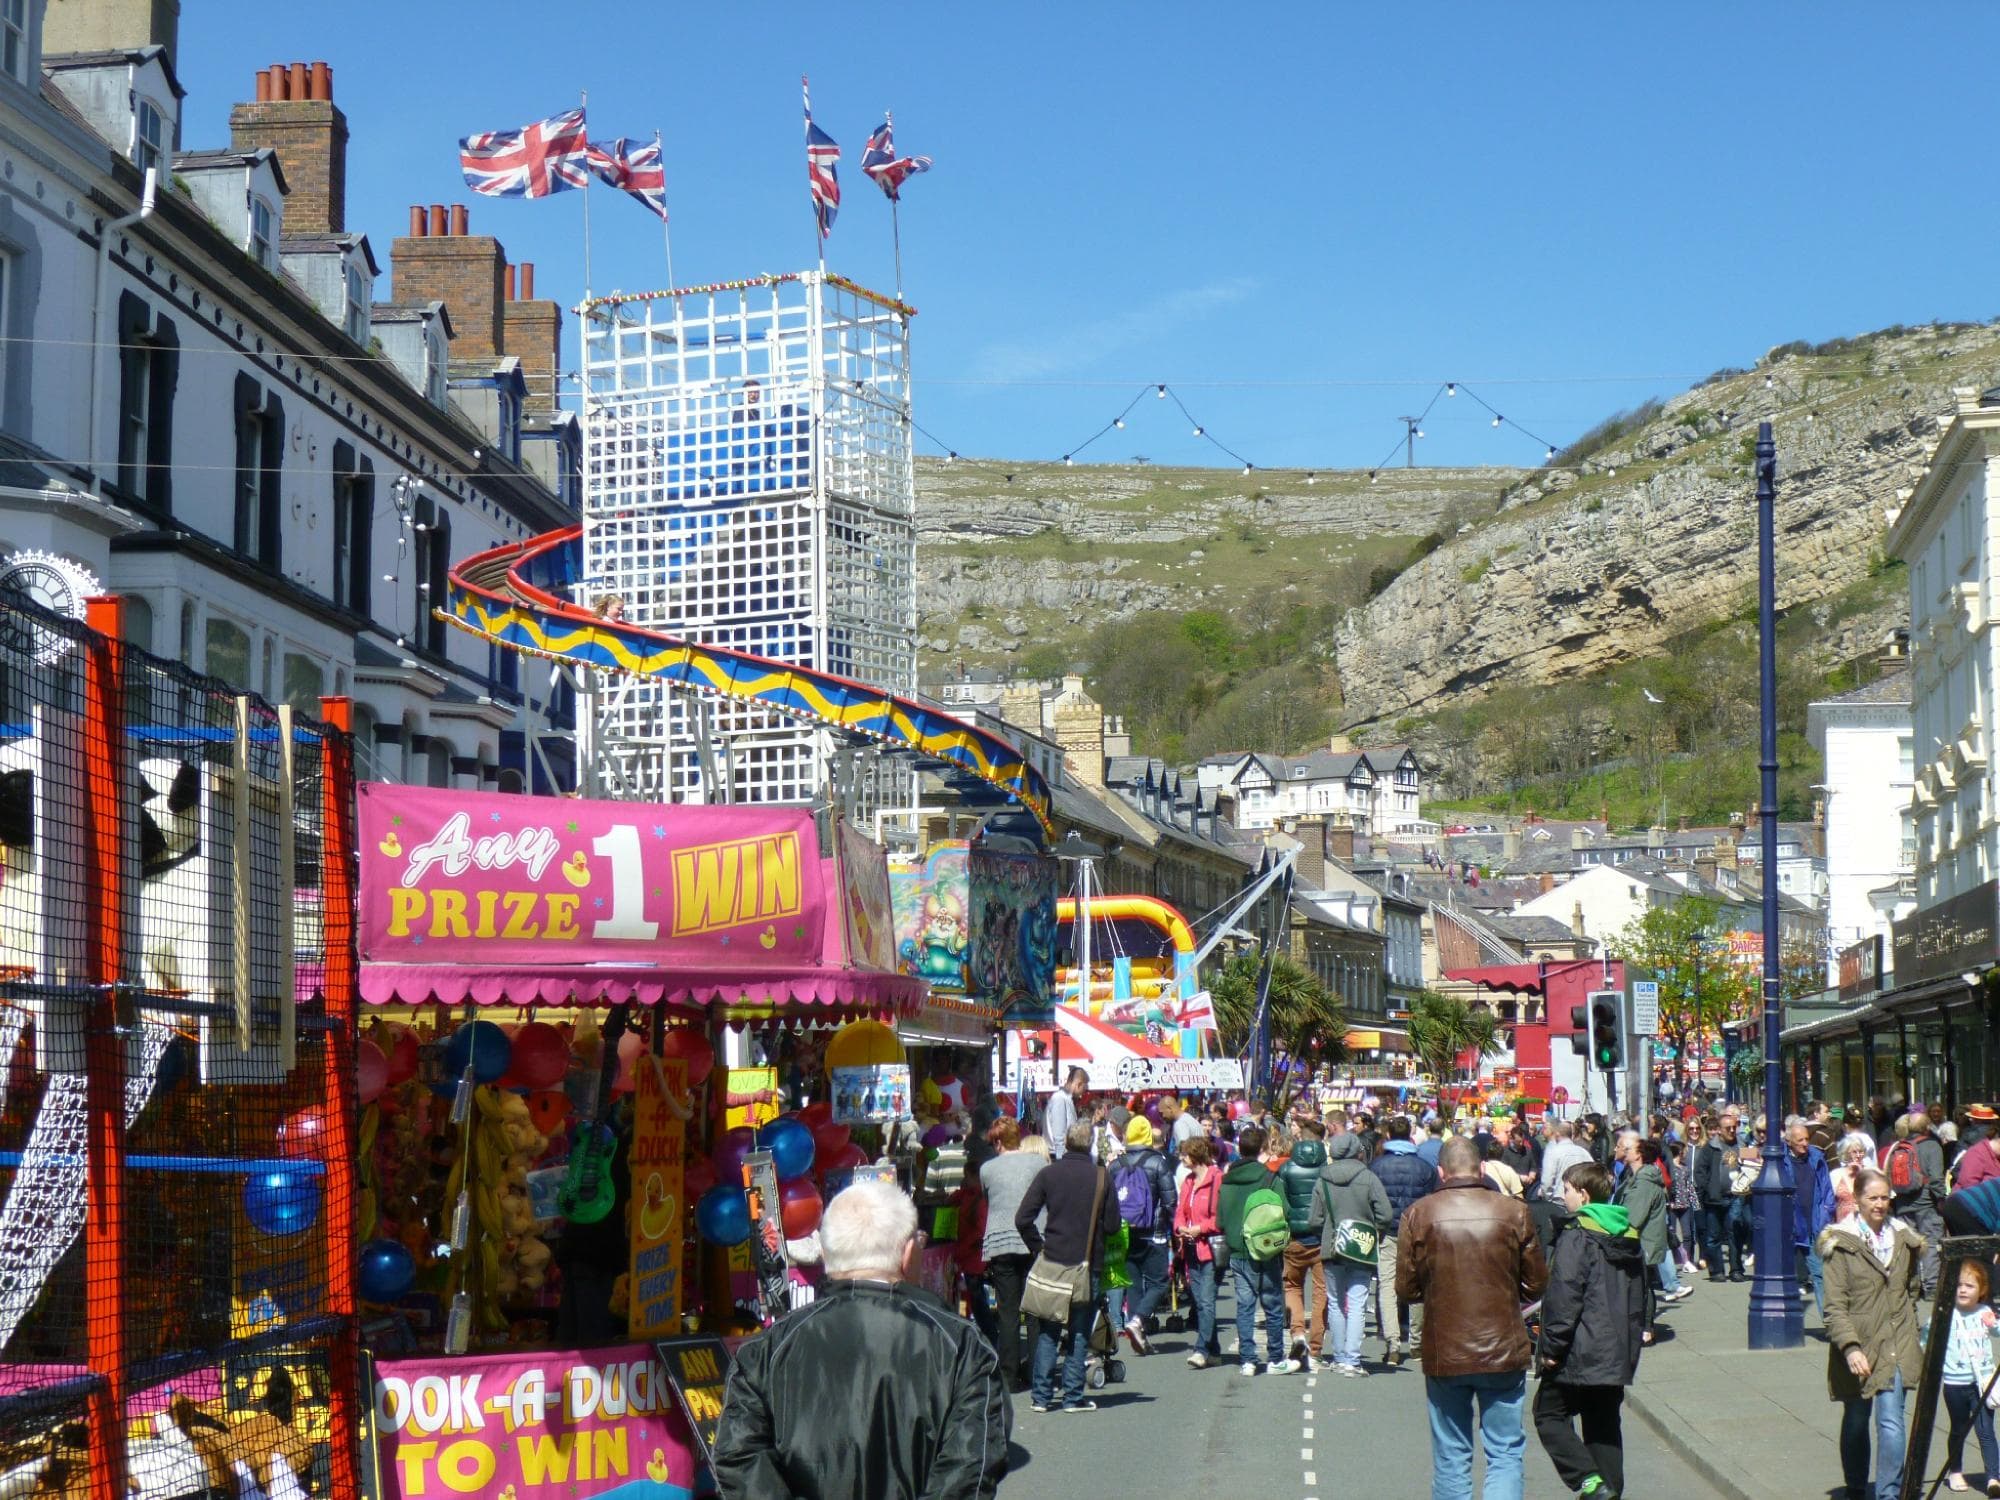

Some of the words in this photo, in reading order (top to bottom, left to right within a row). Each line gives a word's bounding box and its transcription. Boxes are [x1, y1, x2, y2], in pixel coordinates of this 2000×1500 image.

[402, 811, 561, 888] Any
[592, 824, 659, 940] 1
[676, 836, 800, 932] WIN
[387, 888, 580, 940] PRIZE
[1160, 1074, 1209, 1084] CATCHER
[1167, 1062, 1199, 1073] PUPPY
[679, 1347, 720, 1381] ANY
[396, 1439, 496, 1496] TO
[516, 1427, 629, 1487] WIN
